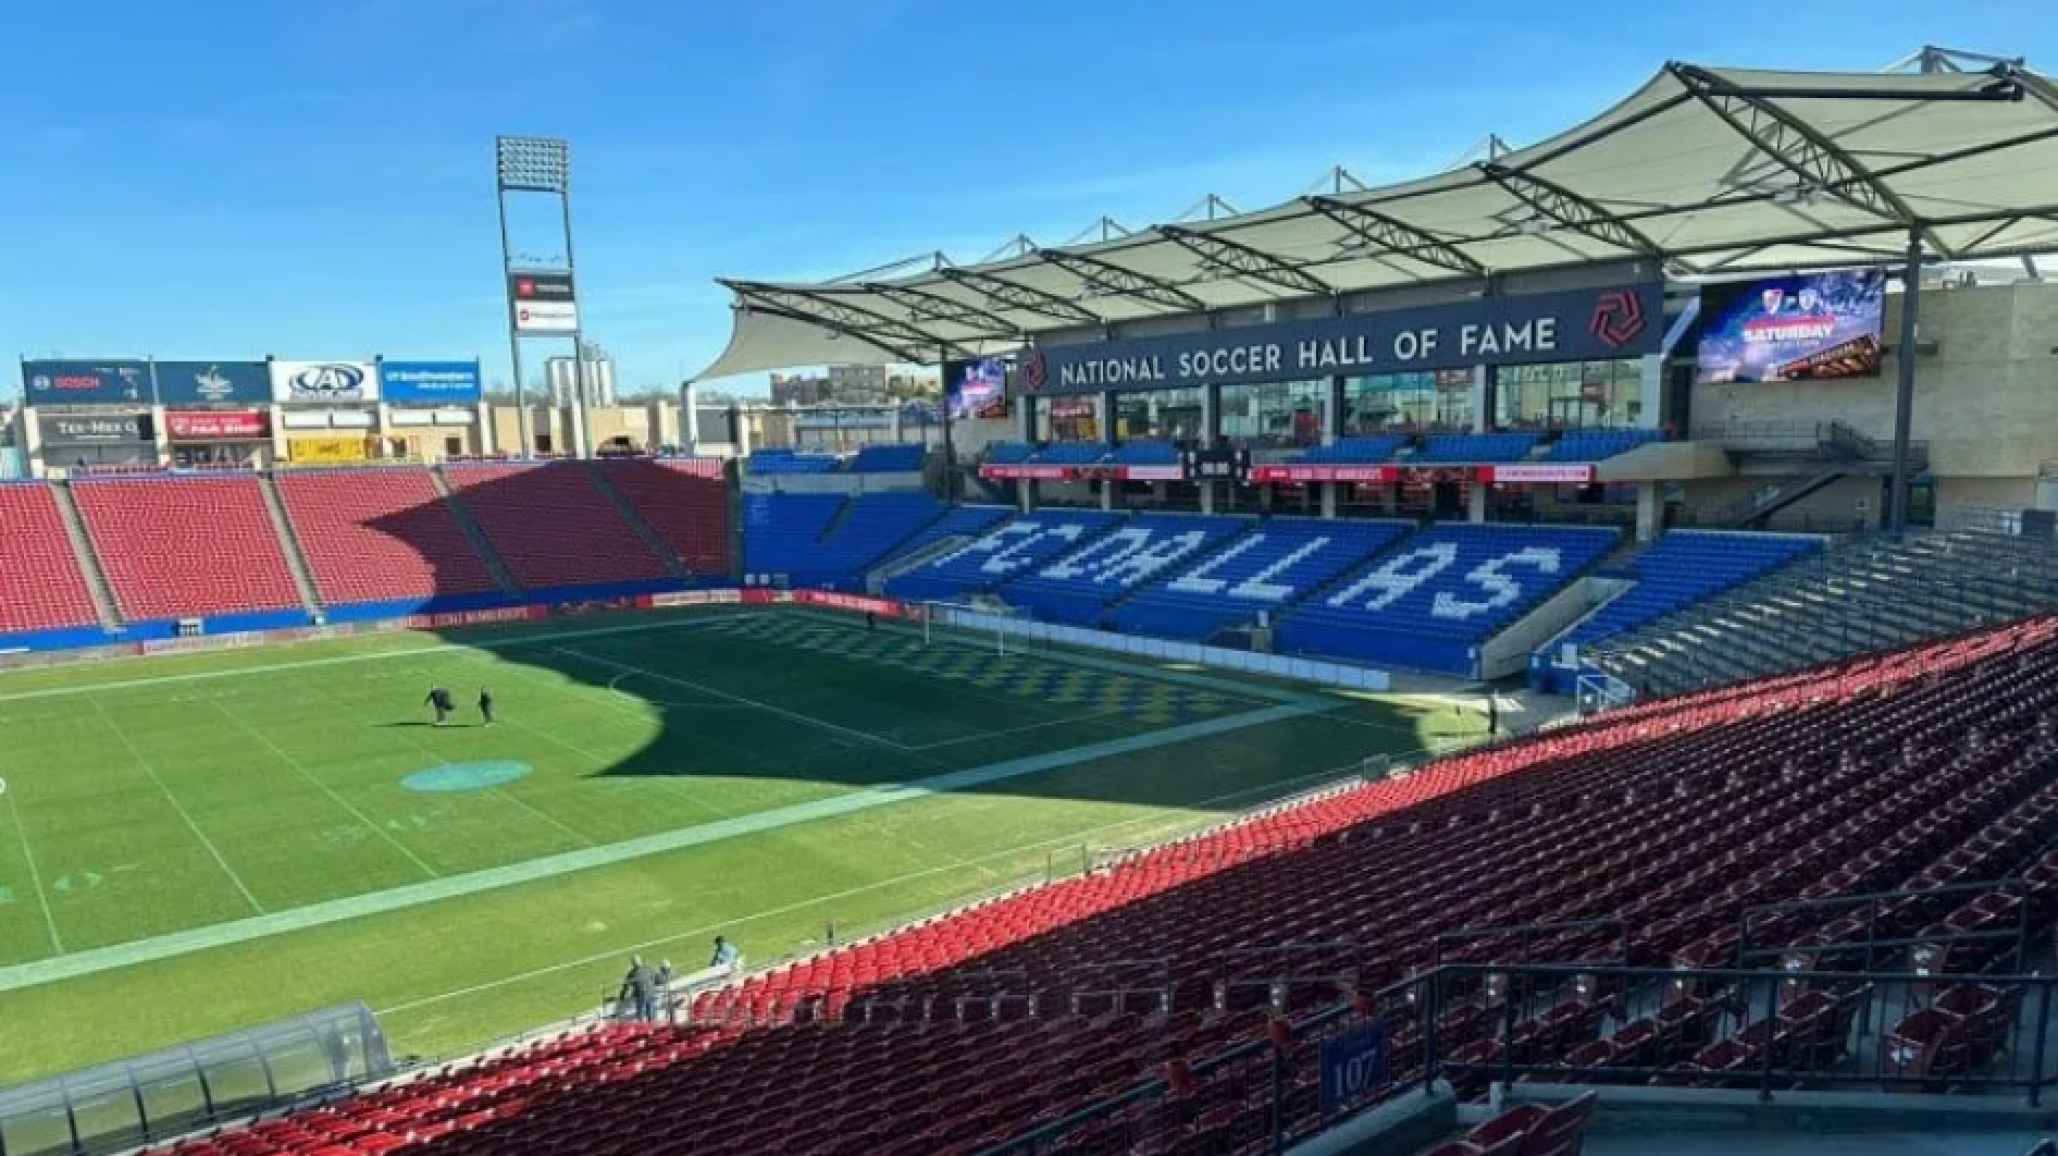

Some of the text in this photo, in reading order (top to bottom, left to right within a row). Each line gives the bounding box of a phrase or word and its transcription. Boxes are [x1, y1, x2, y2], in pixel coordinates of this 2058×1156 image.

[1061, 317, 1555, 385] NATIONAL SOCCER HALL OF FAME
[1743, 323, 1834, 341] SATURDAY
[55, 376, 99, 389] BOSCH
[1039, 527, 1561, 620] DALLAS
[1335, 1049, 1376, 1096] 107
